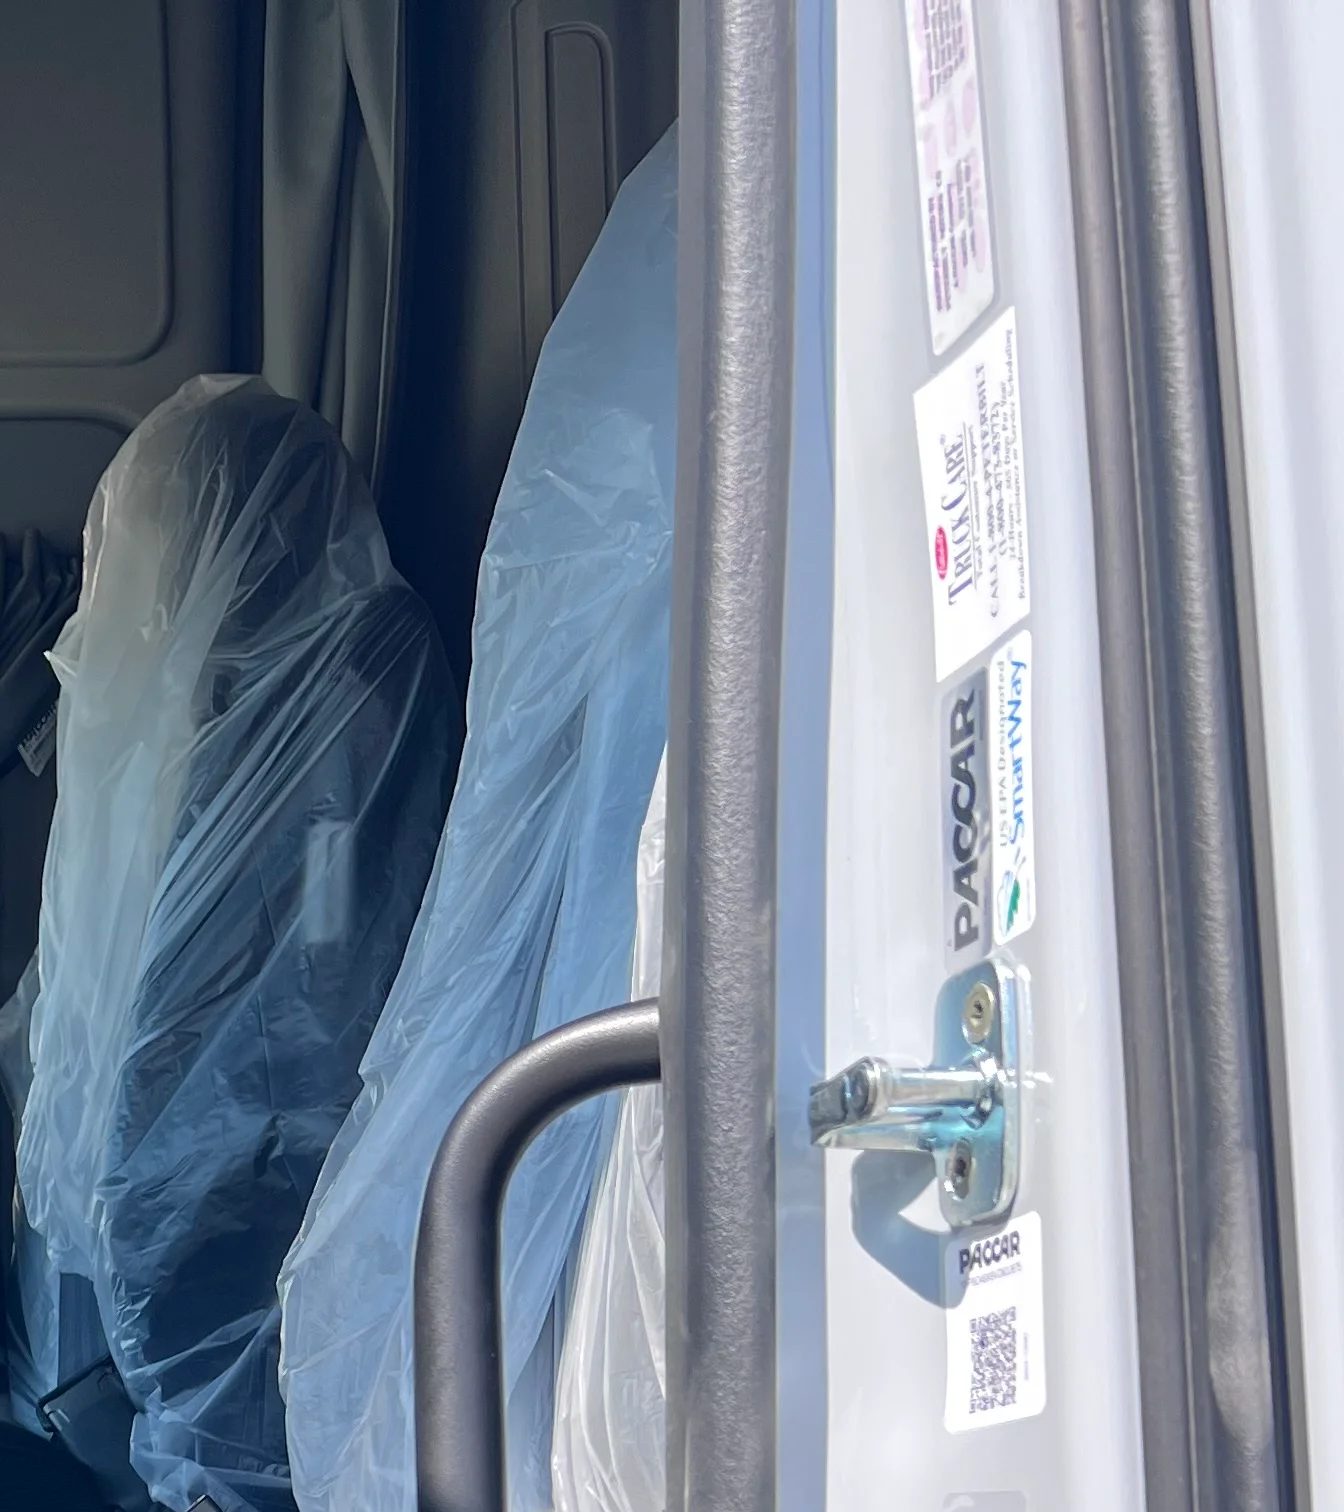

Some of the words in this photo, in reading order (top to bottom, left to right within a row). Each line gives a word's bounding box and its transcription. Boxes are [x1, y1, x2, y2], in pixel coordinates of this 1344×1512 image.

[947, 510, 973, 605] TRUCK
[949, 688, 980, 953] PACCAR
[1006, 657, 1027, 846] SmartWay
[959, 1230, 1020, 1274] PACCAR
